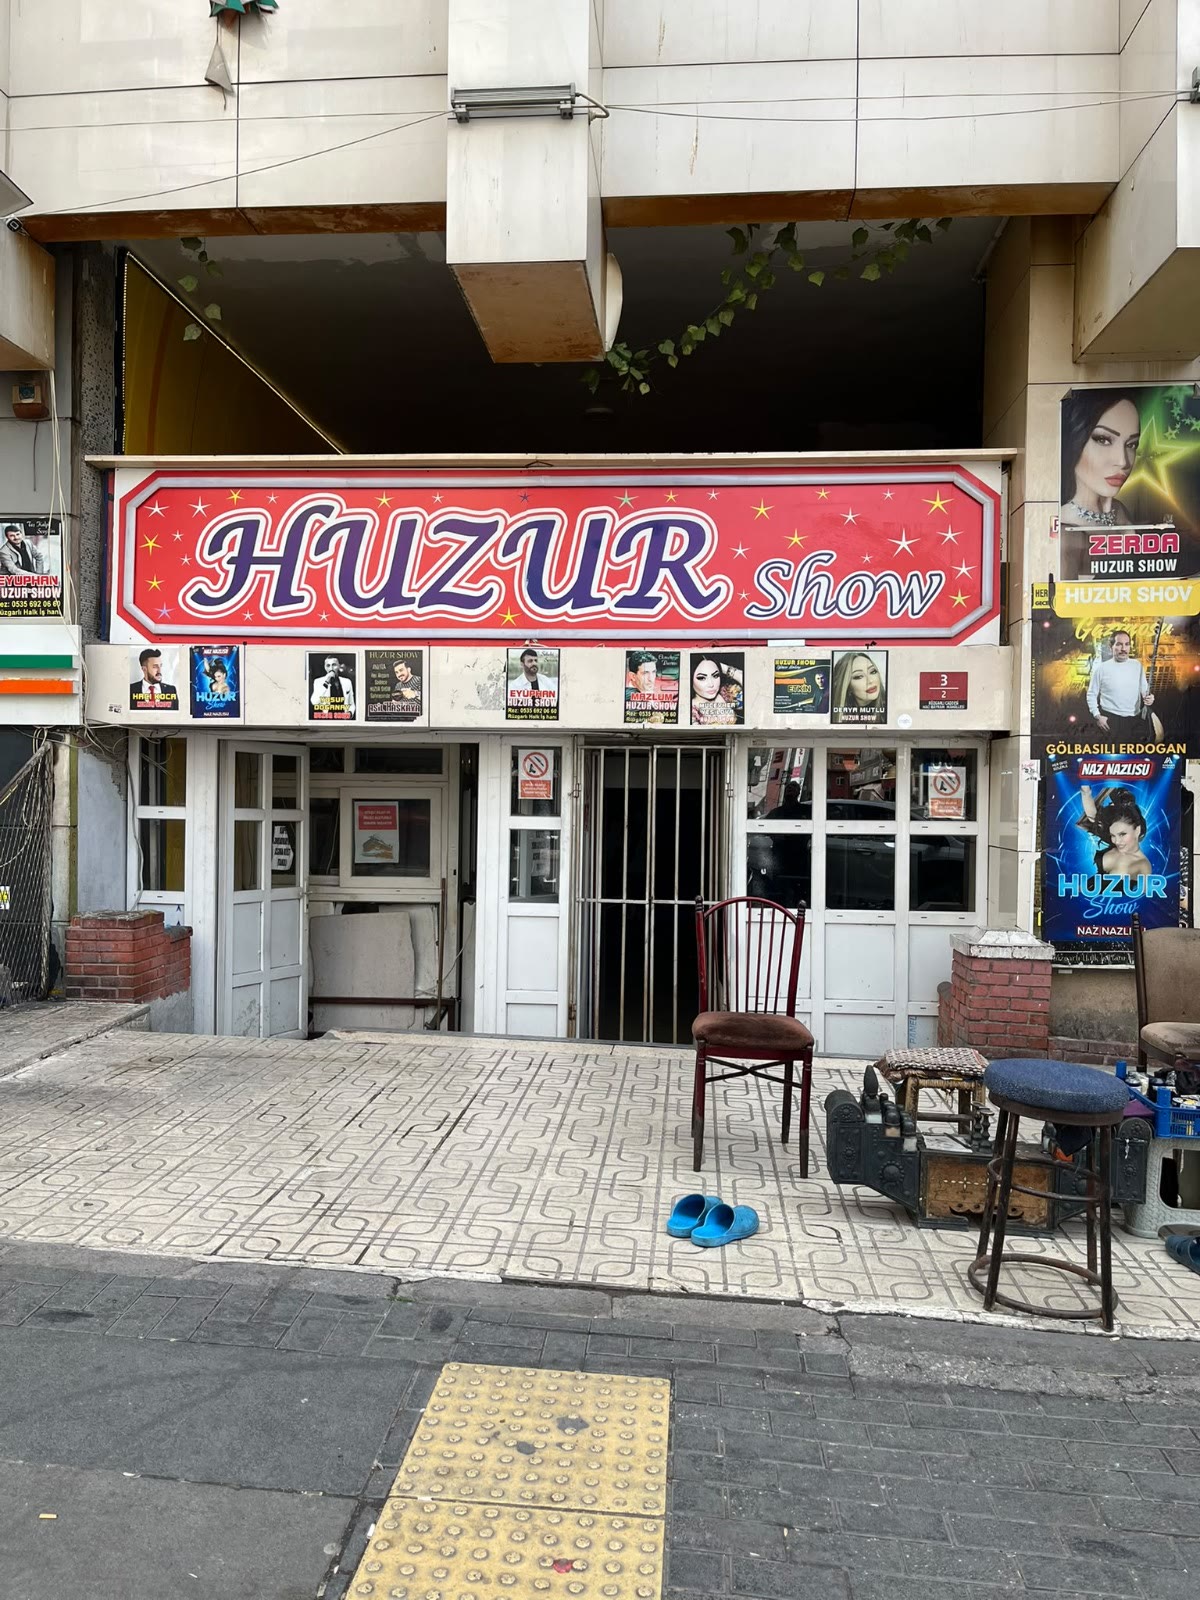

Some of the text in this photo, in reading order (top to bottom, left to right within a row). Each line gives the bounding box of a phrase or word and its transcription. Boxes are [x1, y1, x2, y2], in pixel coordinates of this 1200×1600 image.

[1089, 532, 1180, 555] ZERDA
[178, 492, 946, 623] HUZUR Show
[1090, 559, 1177, 574] HUZUR SHOW
[0, 587, 61, 599] UZUR SHOW
[1035, 588, 1049, 598] HER
[1065, 585, 1193, 604] HUZUR SHOV
[11, 600, 28, 608] 0535
[29, 600, 42, 608] 692
[941, 674, 948, 687] 3
[195, 691, 237, 702] HUZUR
[631, 692, 674, 701] MAZLUM
[941, 690, 947, 699] 2
[507, 698, 557, 707] HUZUR SHOW
[625, 701, 677, 711] HUZUR SHOW
[1081, 763, 1103, 776] NAZ
[1105, 763, 1151, 776] NAZLISU
[1058, 873, 1168, 898] HUZUR
[1083, 894, 1141, 919] Show
[1077, 926, 1099, 936] NAZ
[909, 1016, 918, 1045] PANEL
